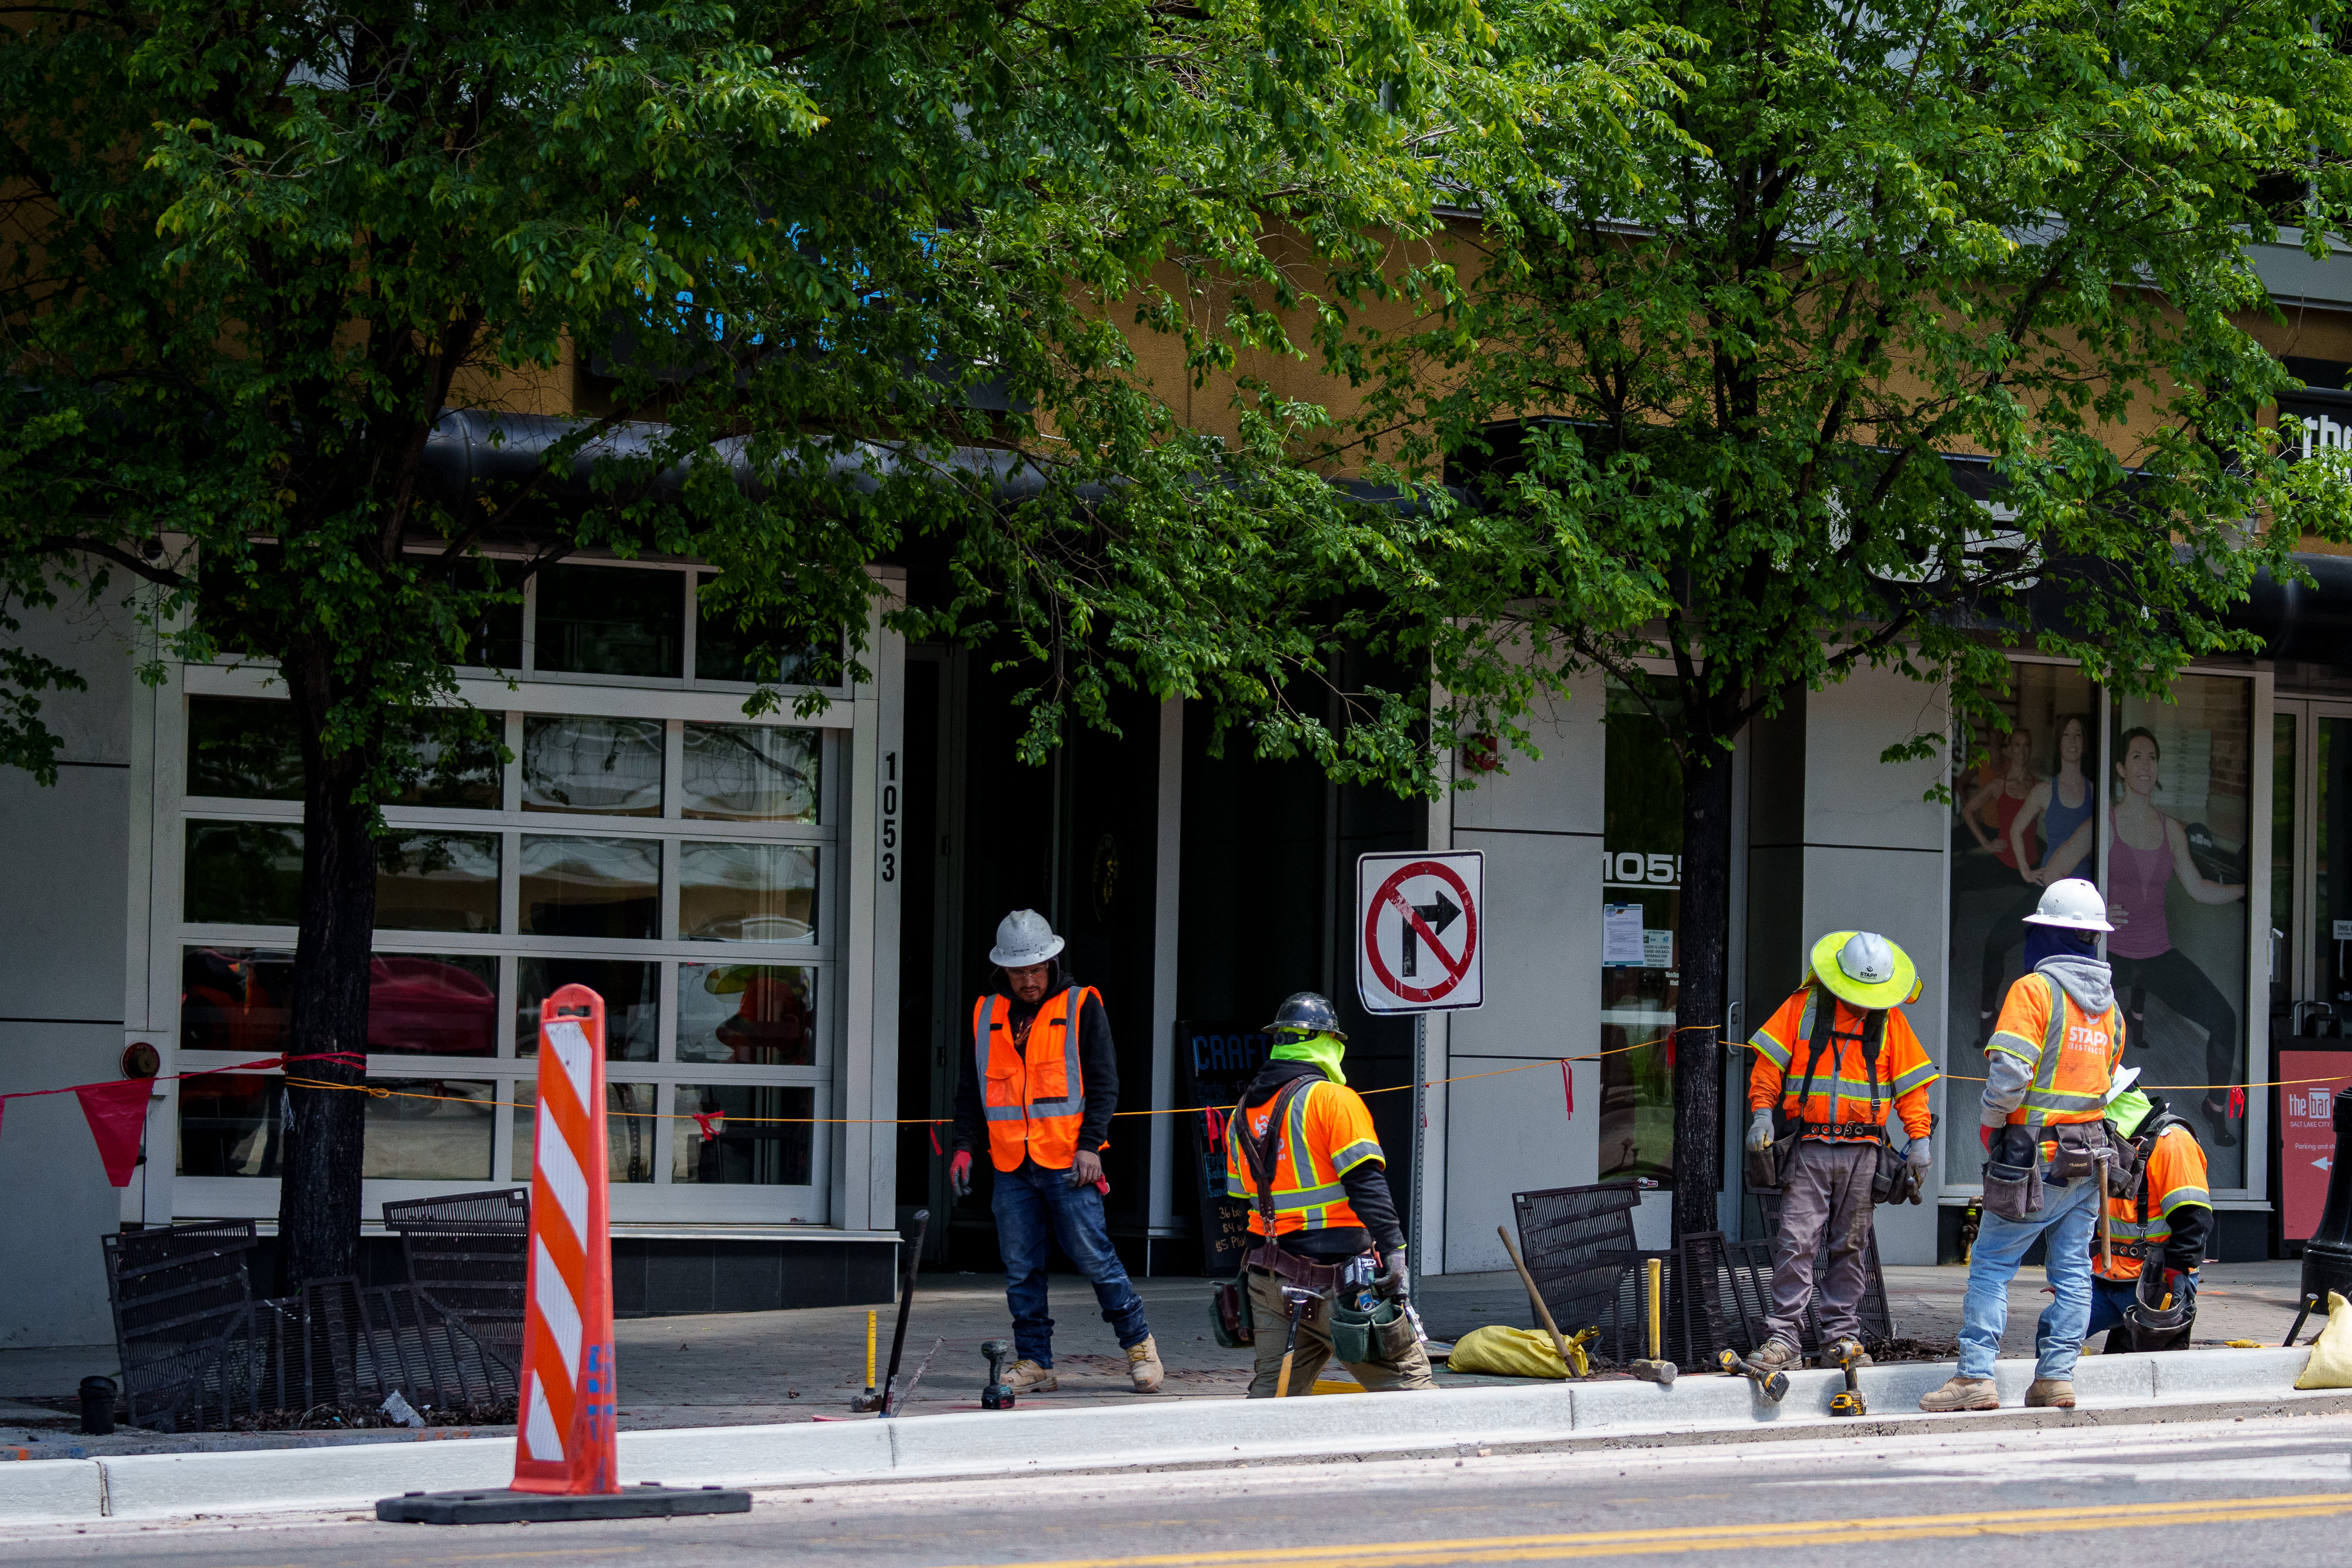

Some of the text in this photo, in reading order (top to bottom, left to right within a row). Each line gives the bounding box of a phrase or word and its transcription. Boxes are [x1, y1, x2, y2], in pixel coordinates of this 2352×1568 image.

[882, 752, 897, 882] 1053
[1603, 851, 1682, 882] 105
[2069, 1026, 2109, 1047] STAPP
[1194, 1035, 1269, 1071] CRAFT
[2289, 1094, 2328, 1116] the bar
[2295, 1142, 2316, 1151] Parking
[1218, 1207, 1230, 1219] 36
[1222, 1222, 1235, 1234] $4
[1215, 1239, 1230, 1253] $5
